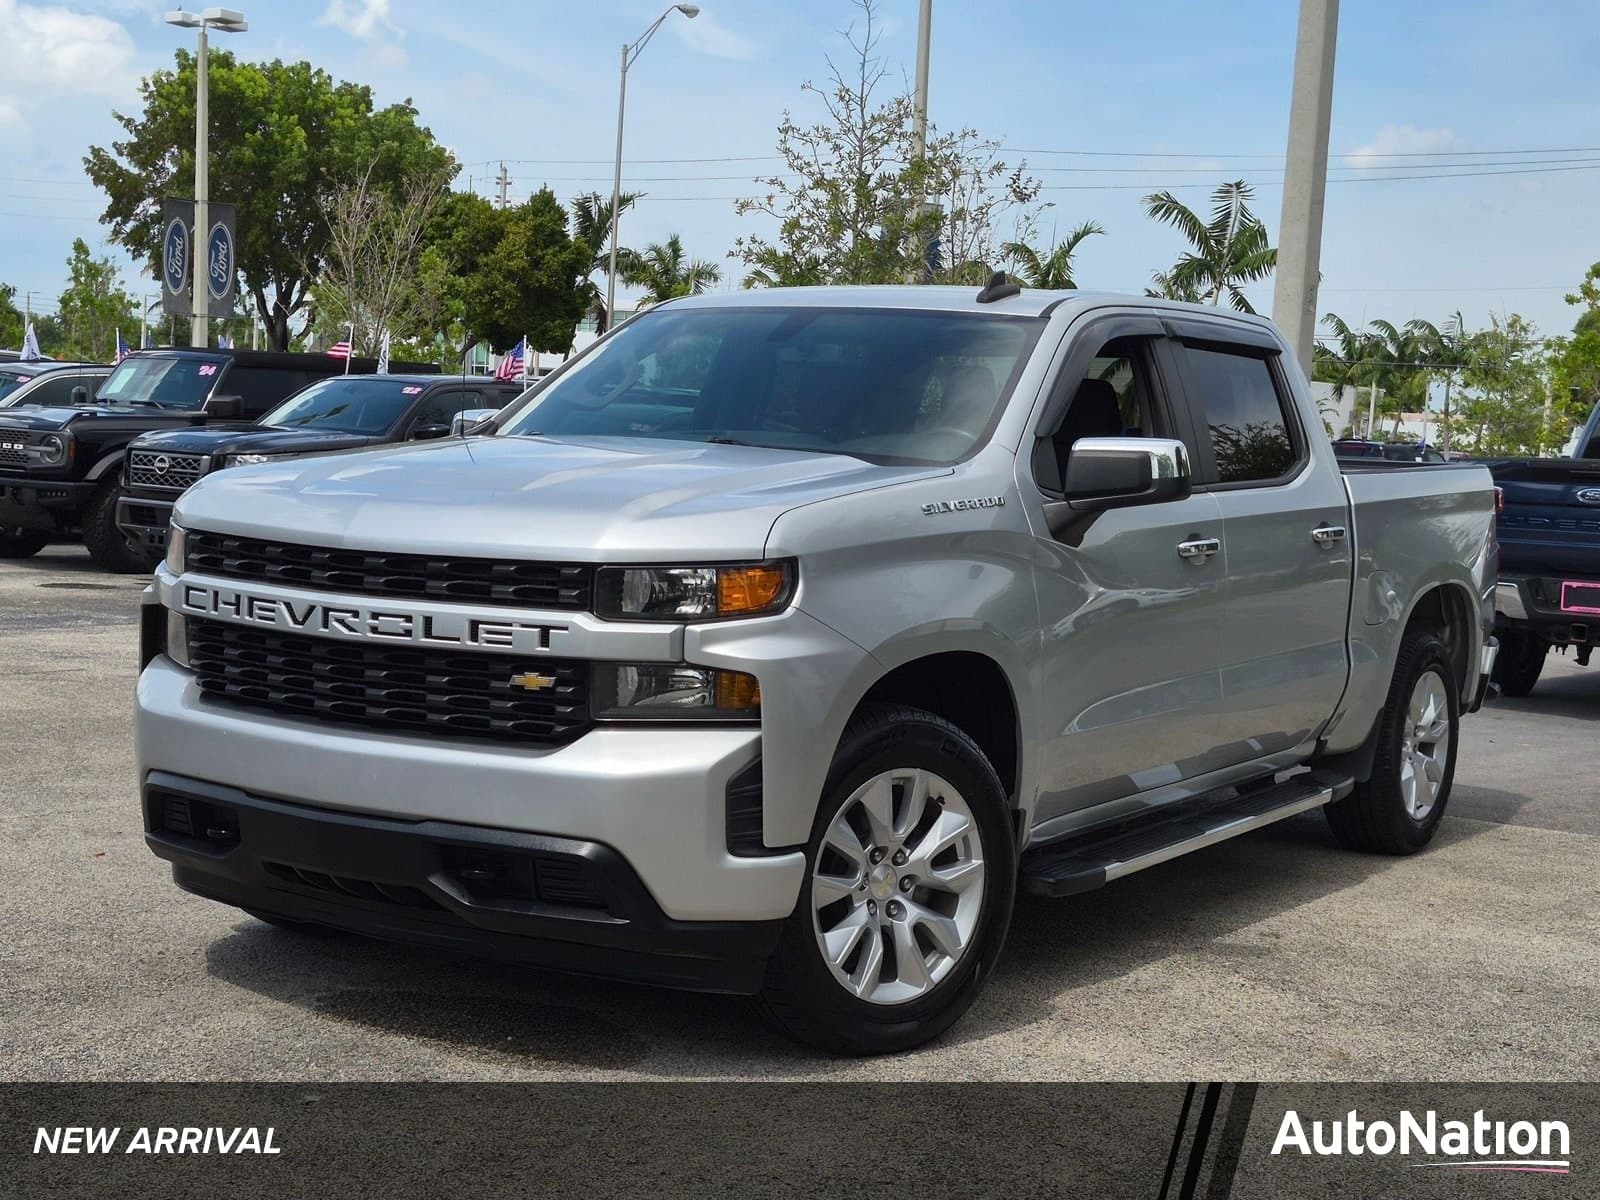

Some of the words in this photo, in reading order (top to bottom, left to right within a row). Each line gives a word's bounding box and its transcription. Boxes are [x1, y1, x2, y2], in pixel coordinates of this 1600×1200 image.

[168, 235, 185, 279] Ford
[210, 240, 228, 283] Ford
[921, 495, 1006, 516] SILVERADO
[183, 585, 570, 651] CHEVROLET
